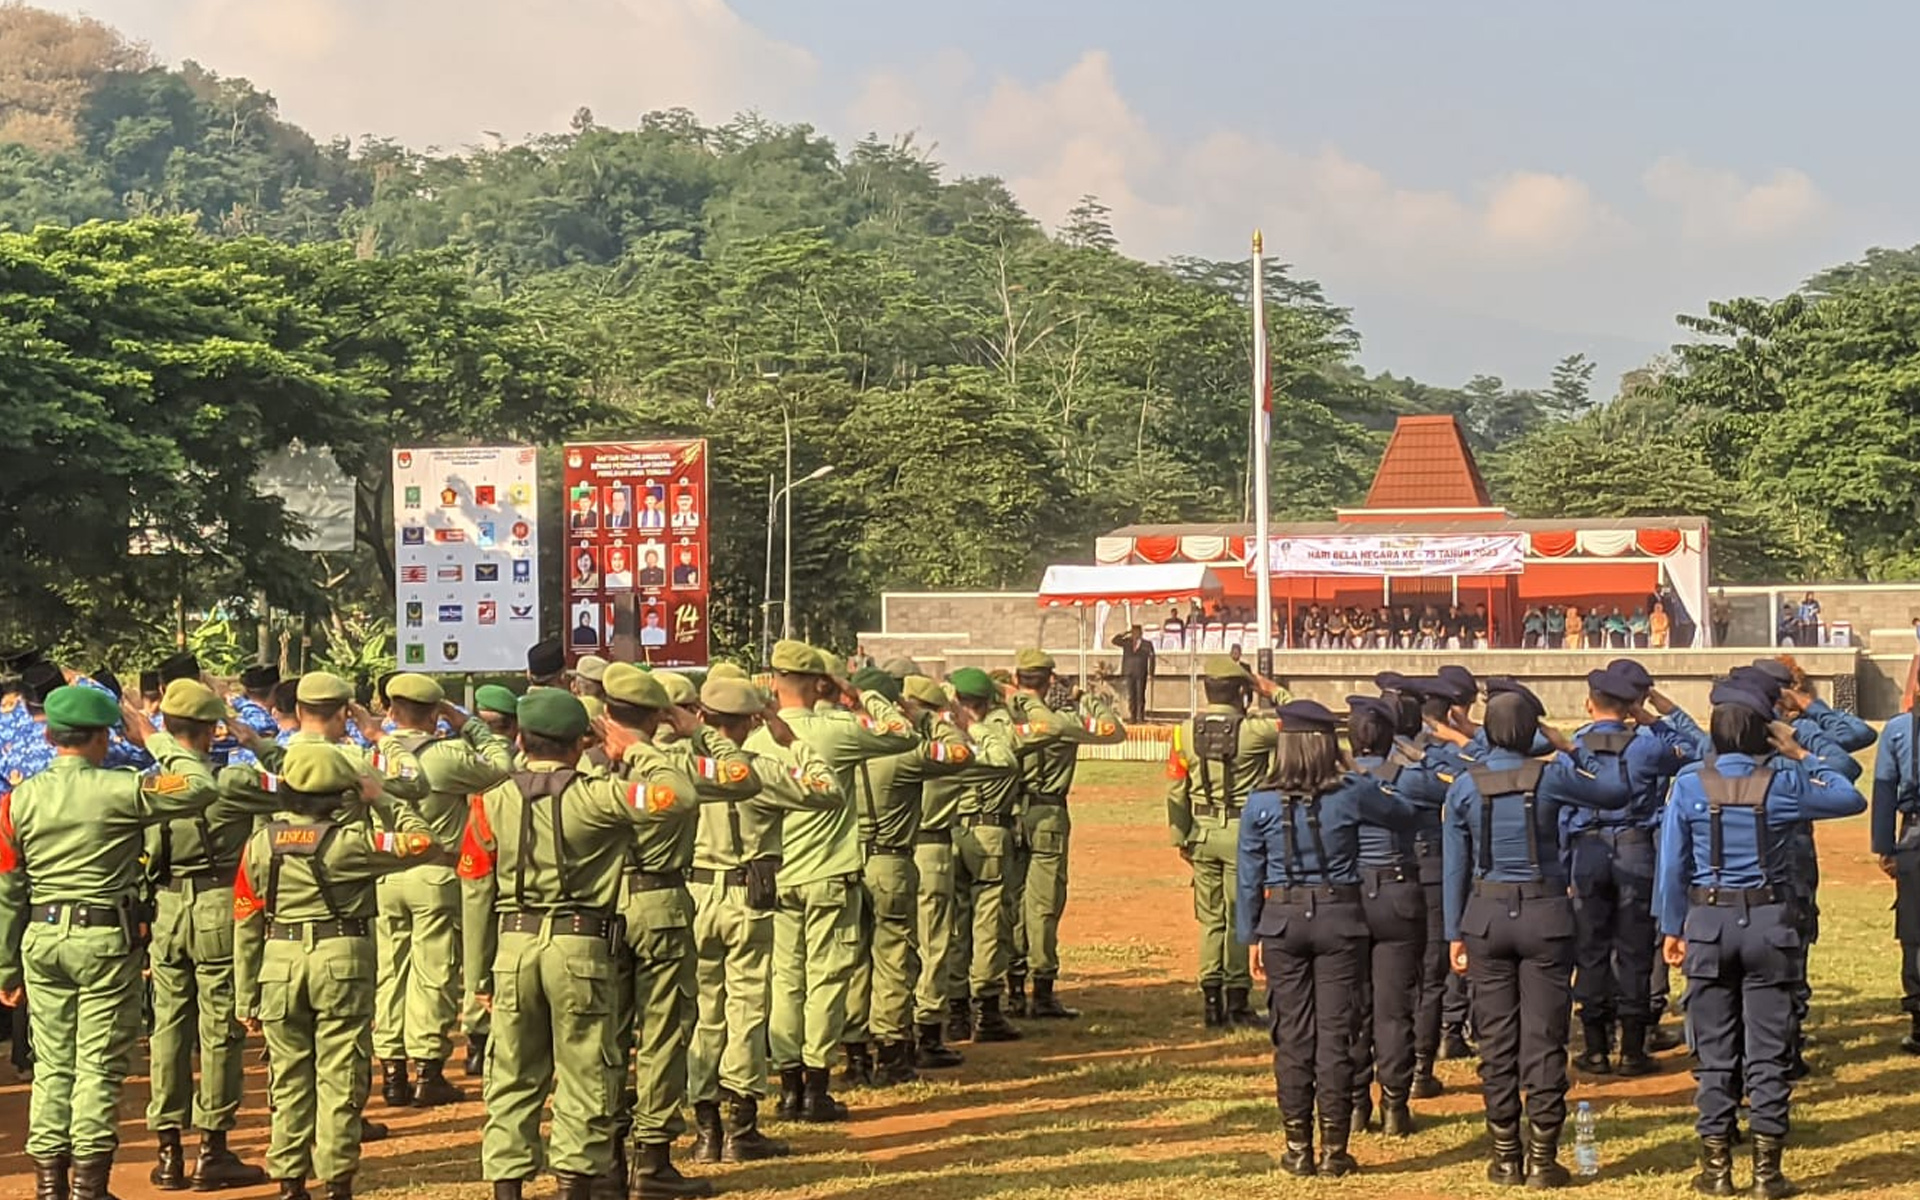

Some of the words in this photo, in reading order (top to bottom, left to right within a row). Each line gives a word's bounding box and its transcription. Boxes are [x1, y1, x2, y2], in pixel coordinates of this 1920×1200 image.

[1308, 550, 1331, 559] HARI
[1333, 550, 1358, 560] BELA
[1360, 550, 1399, 560] NEGARA
[1402, 550, 1415, 558] KE
[1424, 550, 1436, 558] 75
[1439, 549, 1471, 558] TAHUN
